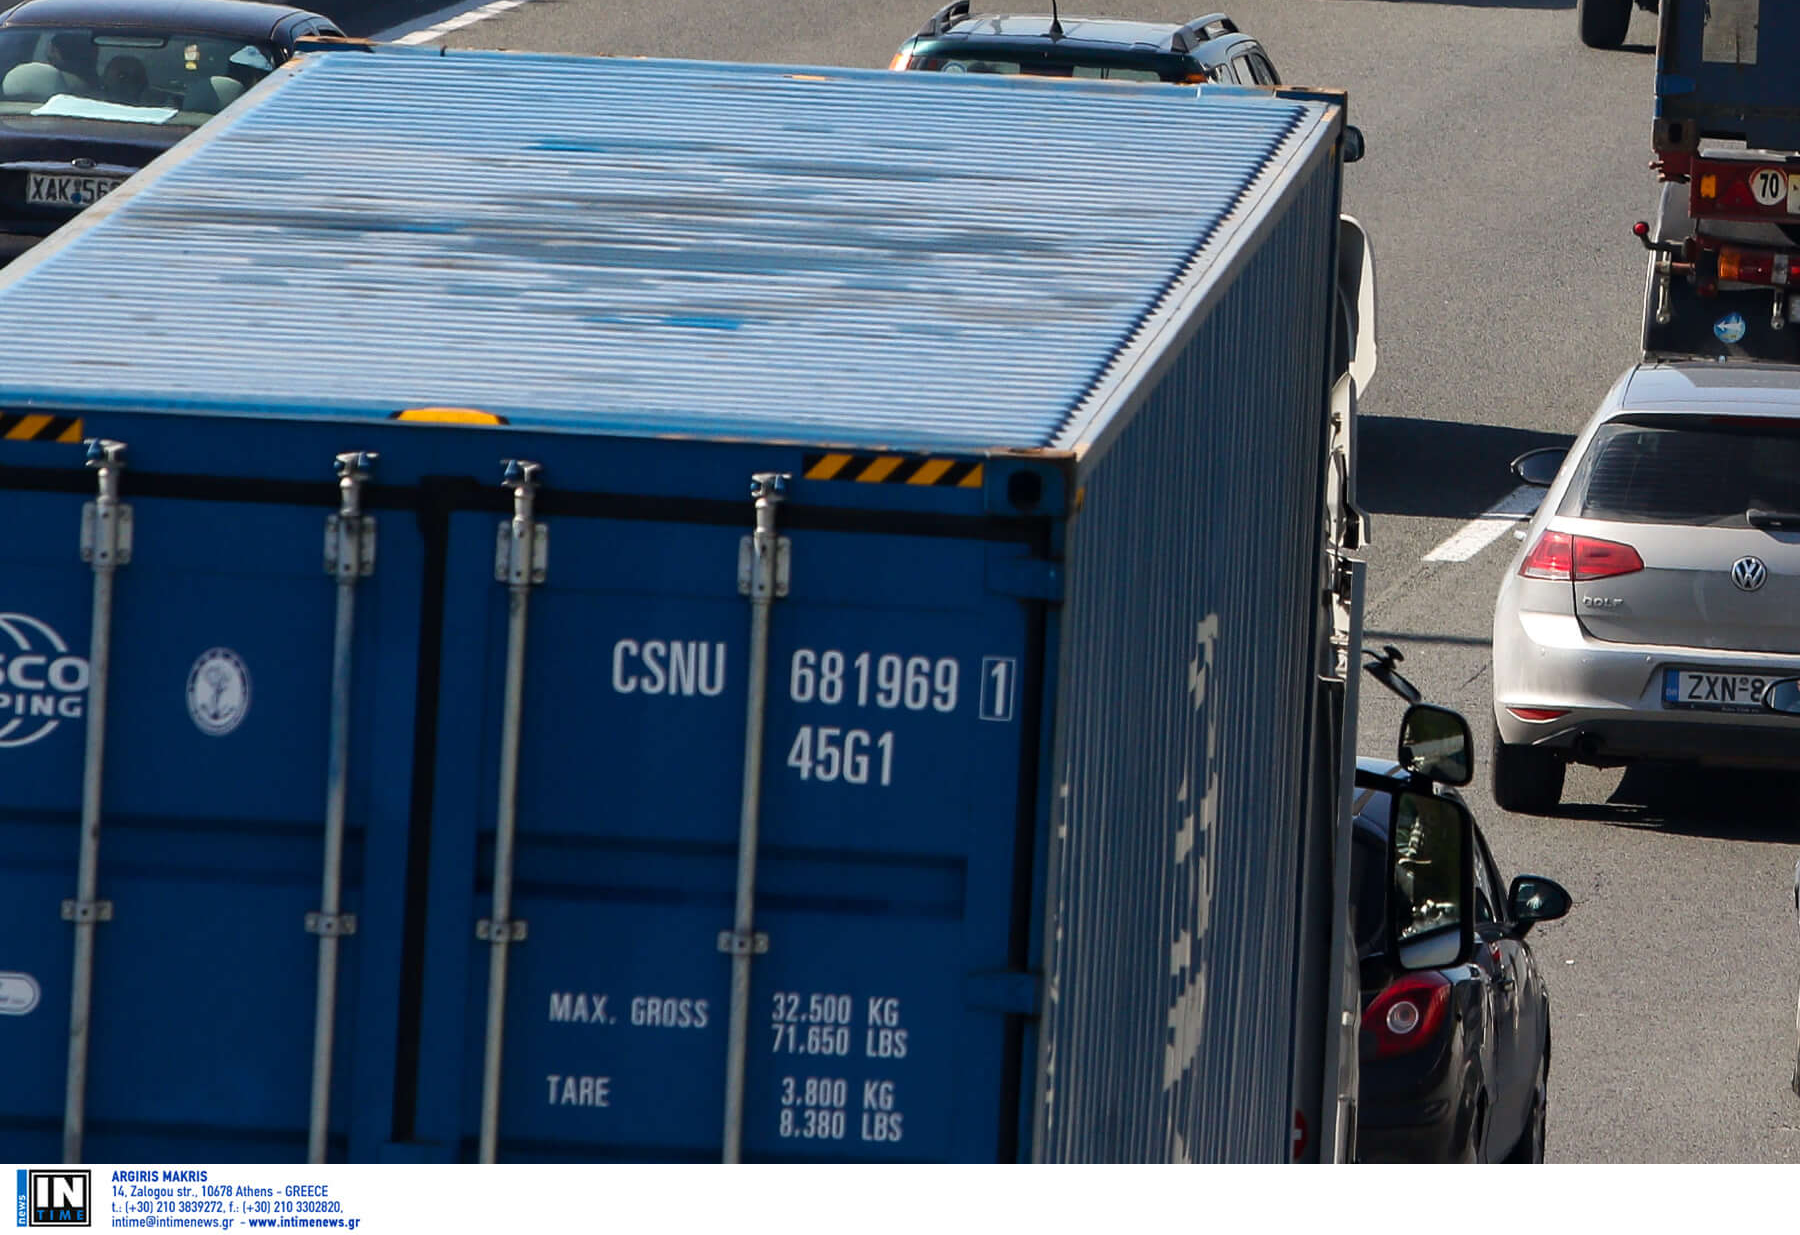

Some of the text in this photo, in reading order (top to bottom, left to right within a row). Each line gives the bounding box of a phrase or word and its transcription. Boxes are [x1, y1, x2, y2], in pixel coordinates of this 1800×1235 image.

[1760, 172, 1779, 198] 70
[612, 639, 727, 697] CSNU
[789, 648, 960, 713] 681969
[787, 725, 895, 787] 45G1
[549, 992, 899, 1028] MAX. GROSS 32.500 KG
[771, 1023, 908, 1059] 71.650 LBS
[546, 1075, 895, 1111] TARE 3.800 KG
[778, 1108, 903, 1143] 8.380 LBS
